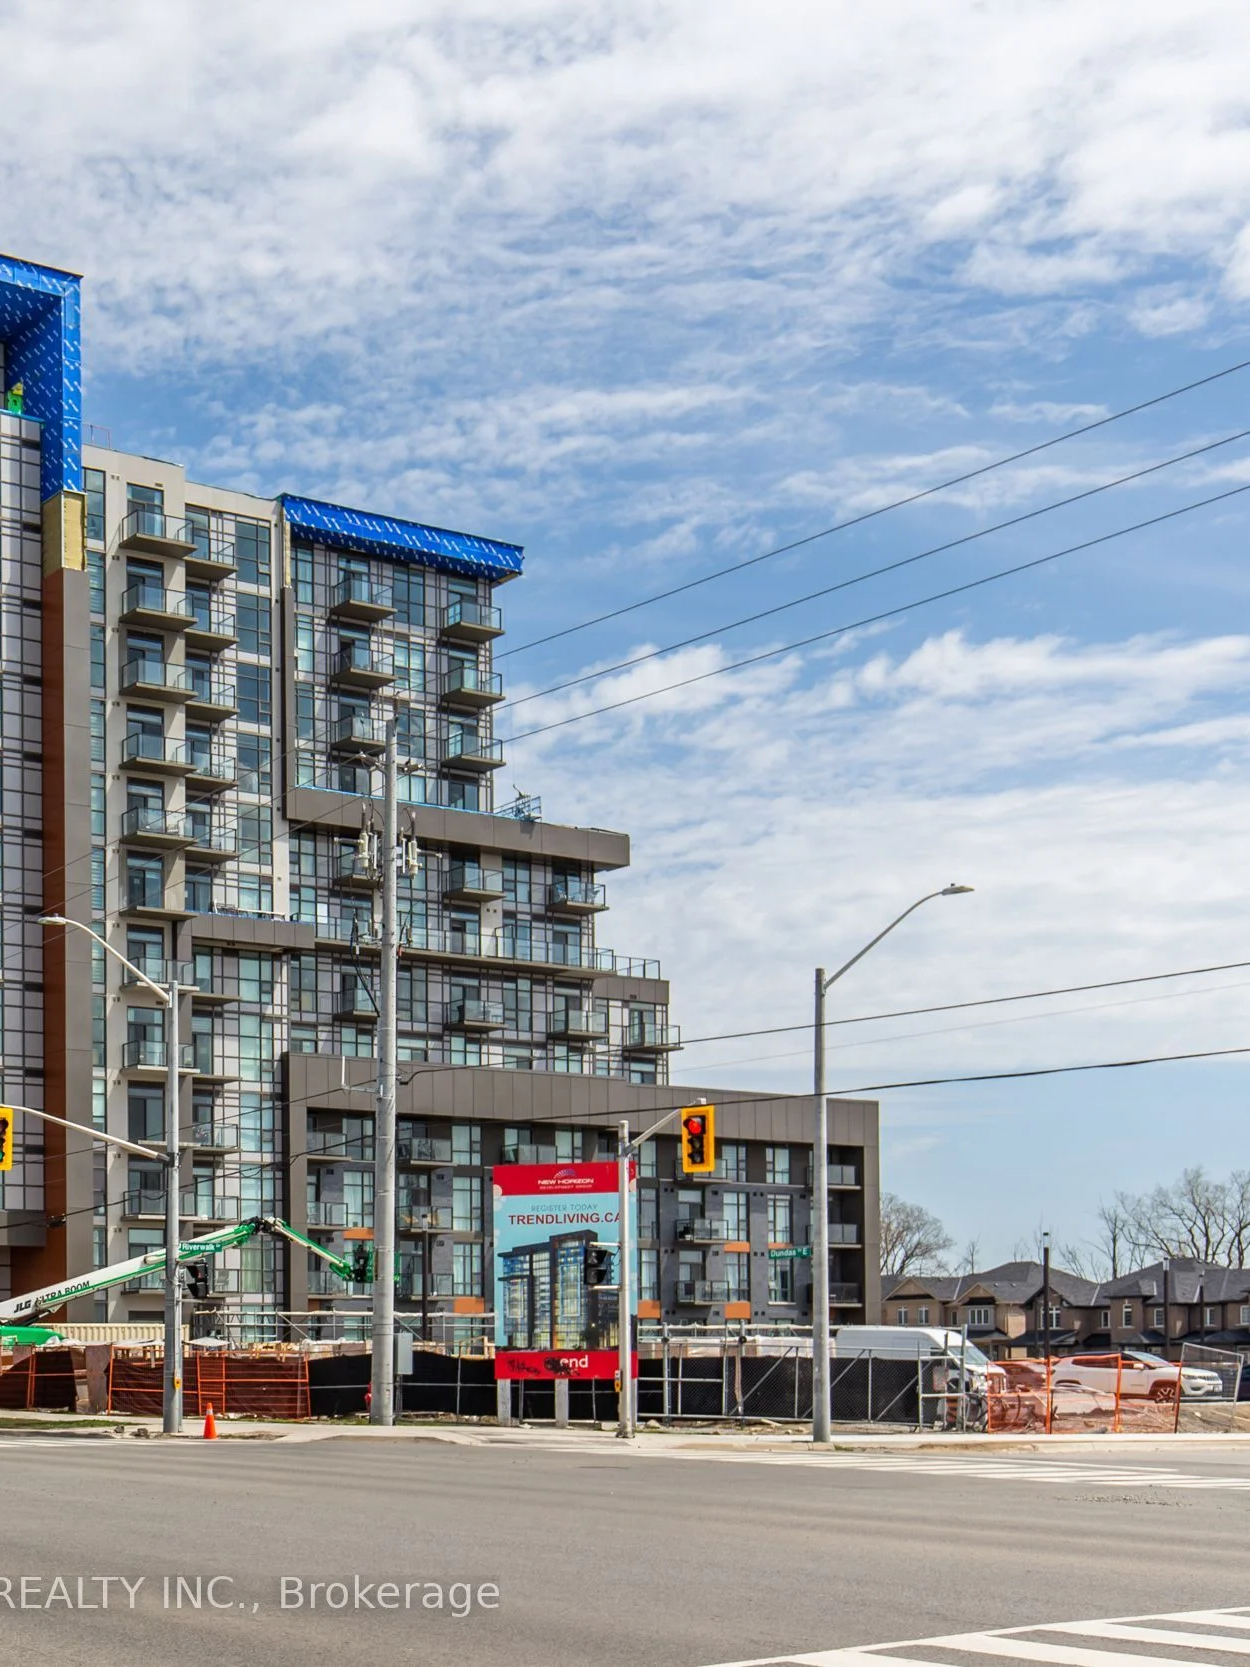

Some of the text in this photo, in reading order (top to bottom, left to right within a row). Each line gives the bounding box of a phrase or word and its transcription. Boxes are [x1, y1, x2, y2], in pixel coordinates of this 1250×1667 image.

[531, 1203, 597, 1212] REGISTER TODAY
[770, 1249, 797, 1258] Dundas
[802, 1247, 808, 1256] E
[14, 1300, 32, 1313] JLG
[65, 1281, 90, 1295] BOOM
